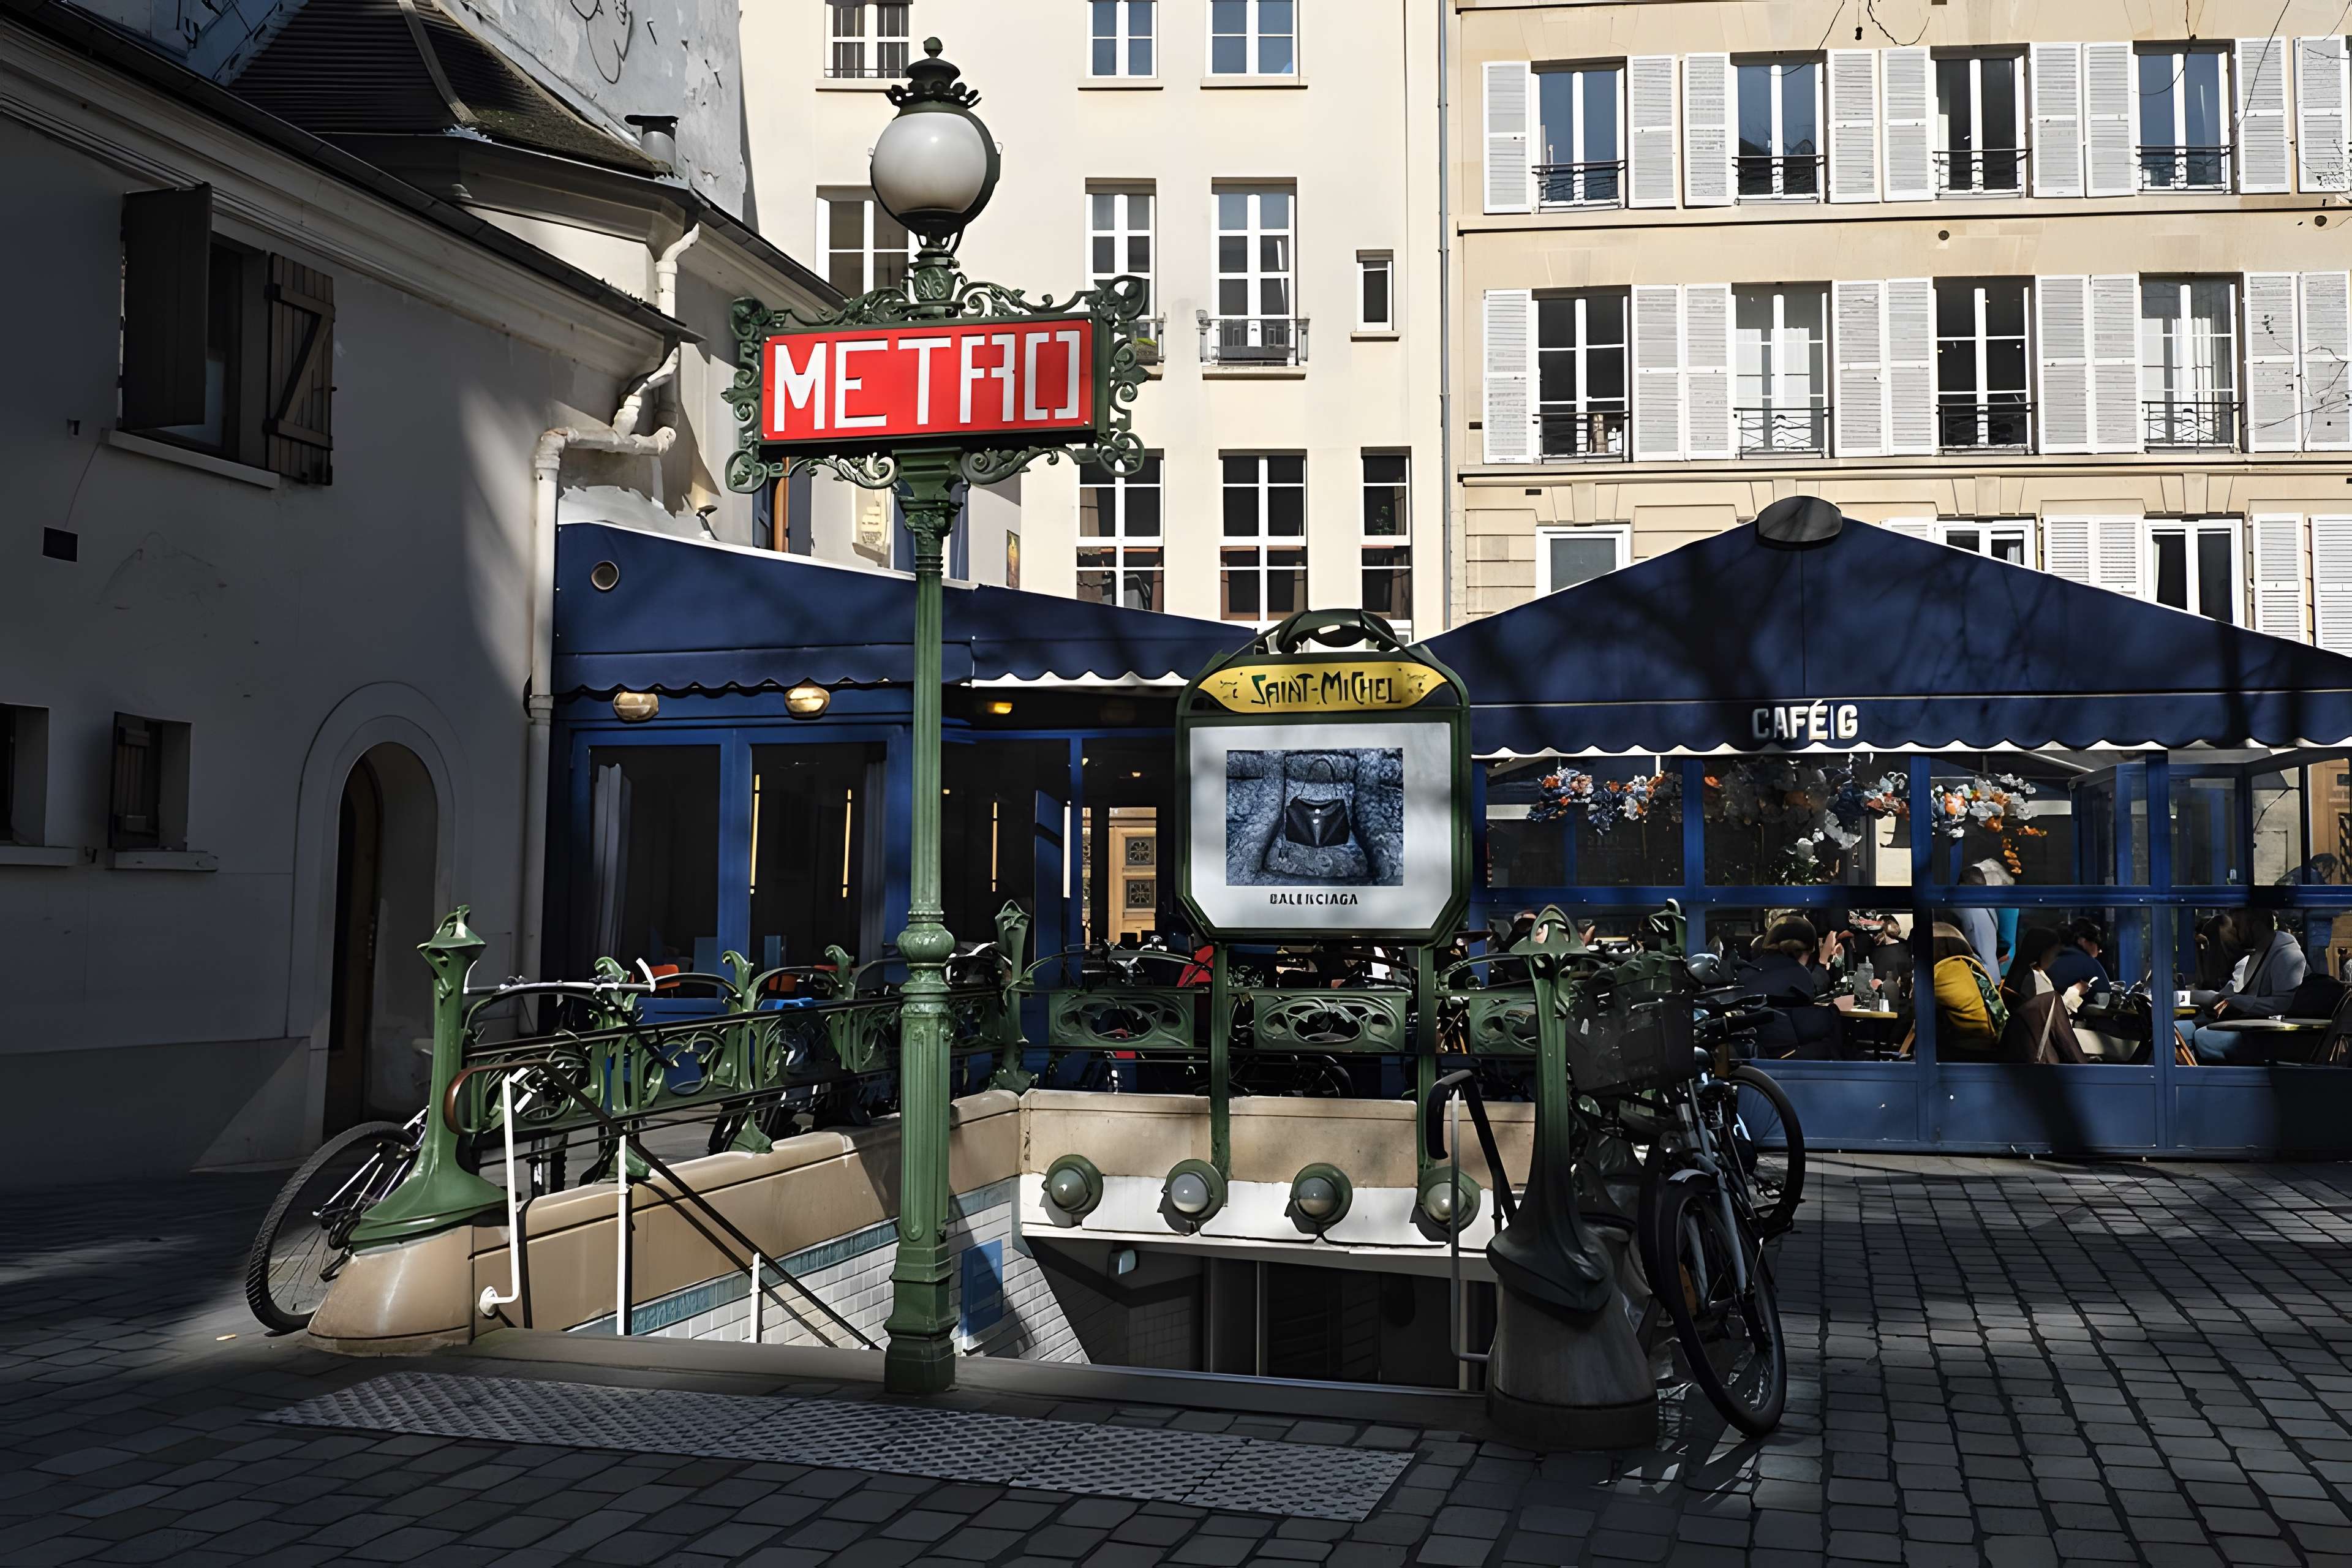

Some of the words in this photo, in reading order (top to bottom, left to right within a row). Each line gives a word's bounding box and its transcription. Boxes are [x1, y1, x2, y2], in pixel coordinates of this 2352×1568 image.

[774, 330, 1080, 432] METRO
[1251, 671, 1402, 708] SAINT-MICHEL
[1270, 893, 1359, 906] BALENCIAGA
